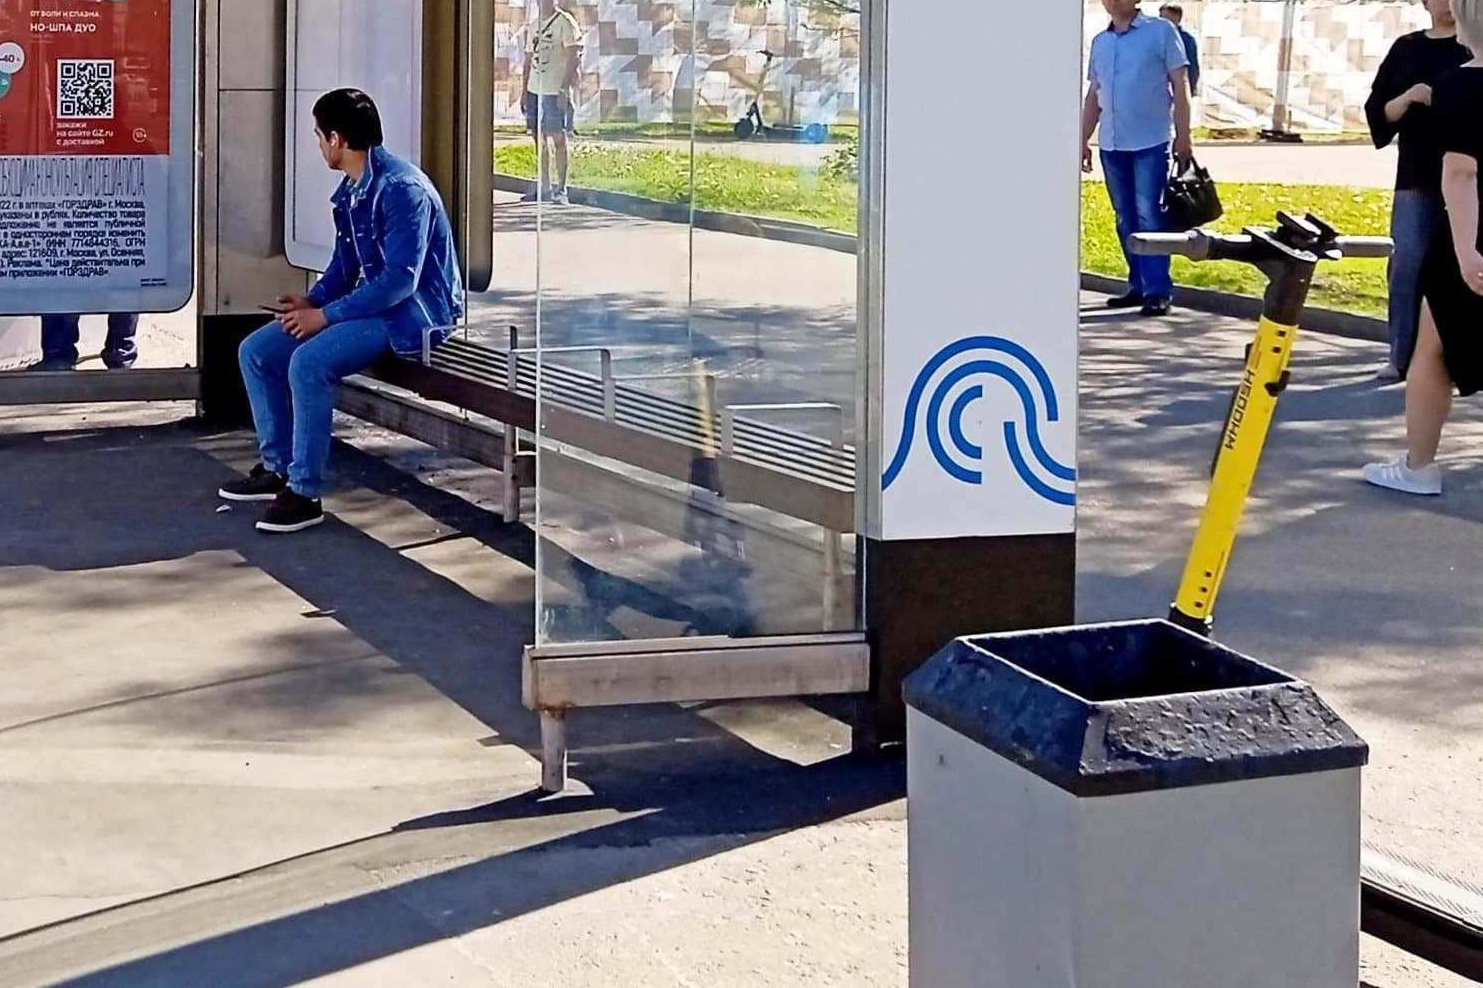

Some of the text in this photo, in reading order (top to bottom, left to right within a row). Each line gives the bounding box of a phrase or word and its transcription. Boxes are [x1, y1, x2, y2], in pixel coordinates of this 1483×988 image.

[30, 23, 96, 32] НО-ШПА ДУО
[1224, 370, 1256, 450] WHOOSH
